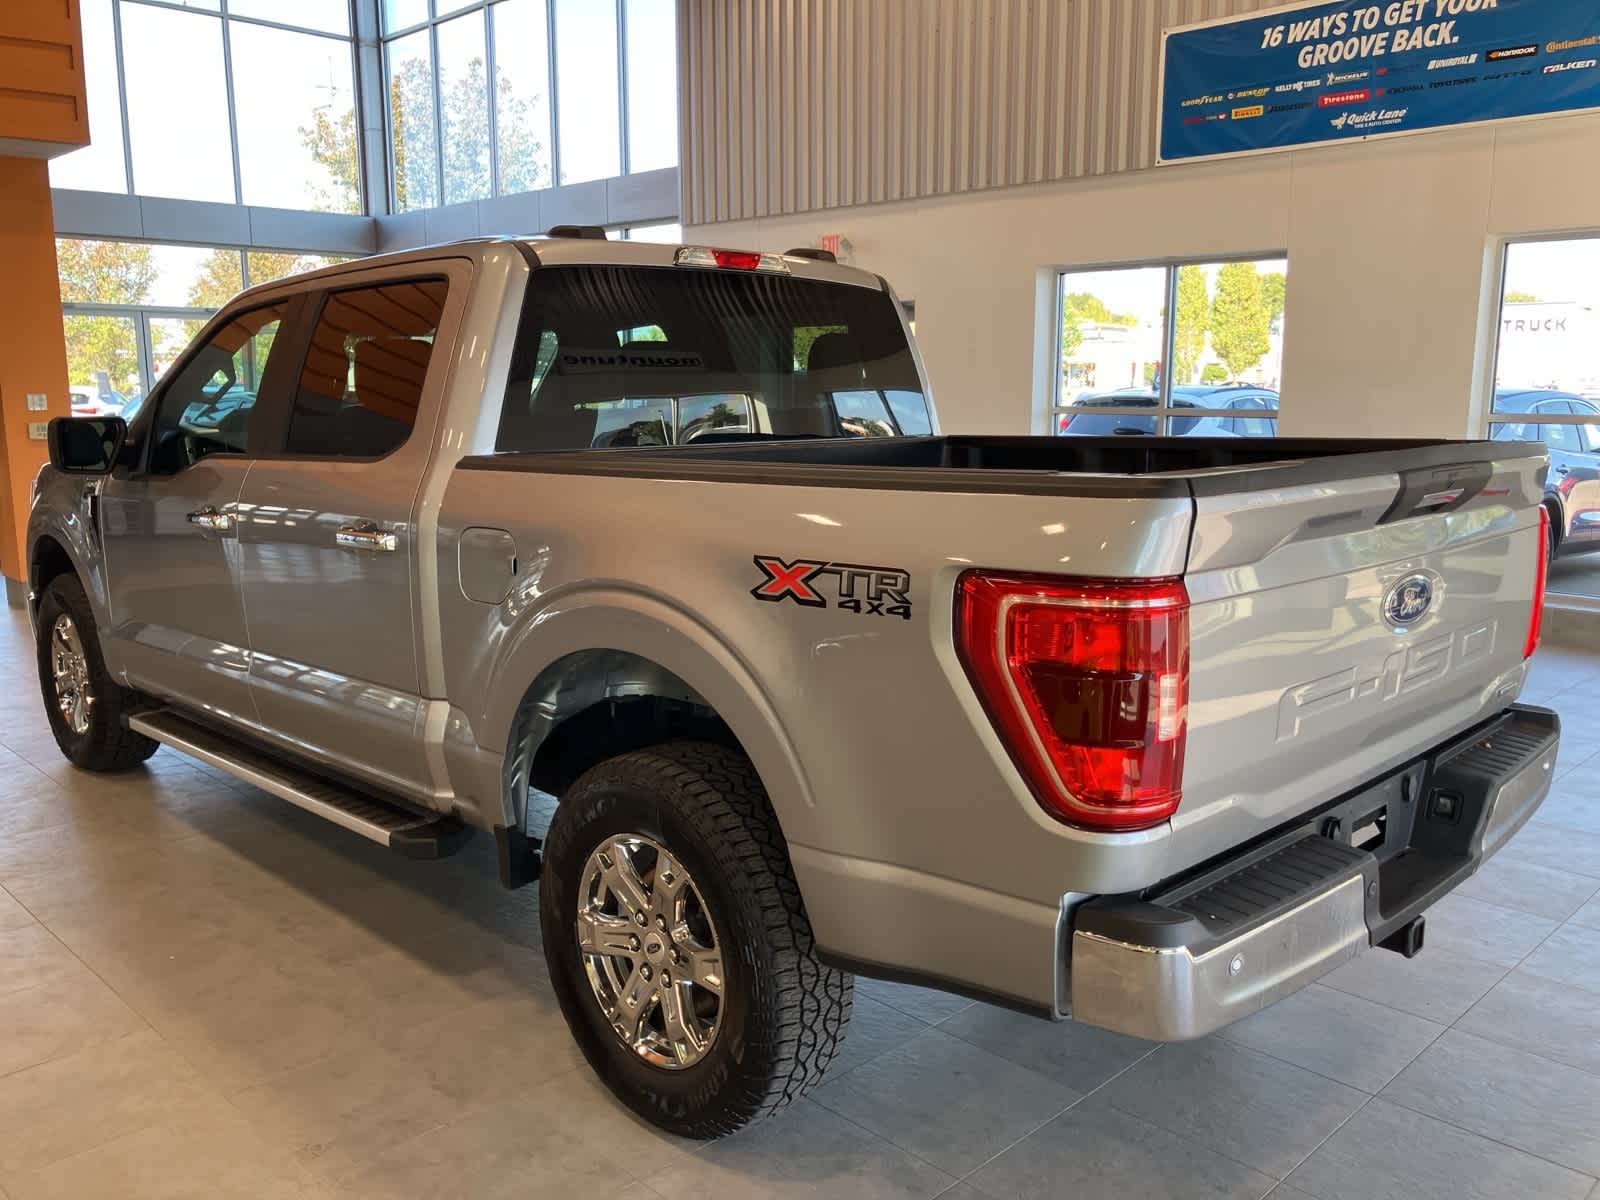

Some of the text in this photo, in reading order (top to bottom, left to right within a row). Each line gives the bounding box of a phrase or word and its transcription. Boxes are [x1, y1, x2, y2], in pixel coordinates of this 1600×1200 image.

[1261, 26, 1284, 48] 16
[1287, 12, 1349, 44] WAYS
[1352, 6, 1381, 33] TO
[1384, 0, 1429, 26] GET
[1297, 20, 1460, 68] GROOVE BACK.
[1346, 110, 1377, 125] Quick
[1503, 318, 1567, 332] TRUCK
[751, 555, 913, 608] XTR
